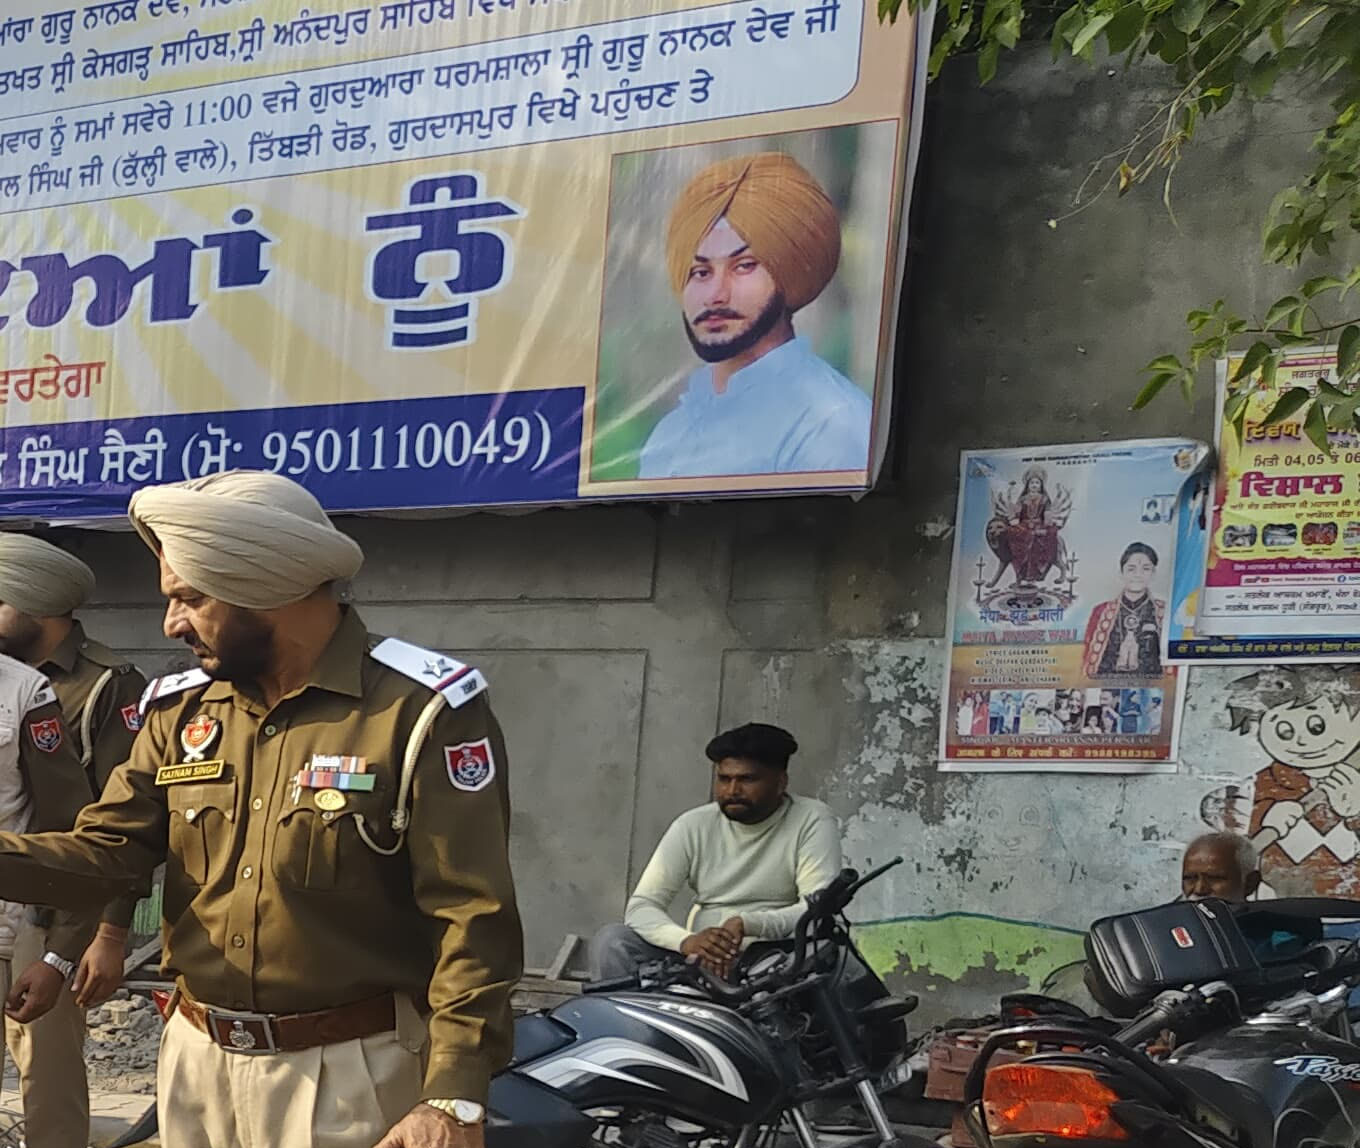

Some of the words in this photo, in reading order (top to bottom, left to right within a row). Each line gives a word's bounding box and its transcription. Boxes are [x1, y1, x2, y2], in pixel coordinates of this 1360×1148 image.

[41, 10, 76, 44] ਗੁਰੂ
[83, 0, 139, 29] ਨਾਨਕ
[273, 9, 370, 45] ਅਨੰਦਪੁਰ
[50, 115, 67, 156] ਨੂੰ
[74, 111, 115, 143] ਸਮਾਂ
[122, 101, 174, 136] ਸਵੇਰੇ
[183, 93, 253, 128] 11:00
[262, 80, 301, 114] ਵਜੇ
[309, 69, 425, 114] ਗੁਰਦੁਆਰਾ
[602, 34, 648, 72] ਗੁਰੂ
[659, 20, 736, 56] ਨਾਨਕ
[745, 8, 795, 42] ਦੇਵ
[804, 0, 842, 35] ਜੀ
[29, 162, 72, 194] ਸਿੰਘ
[80, 155, 104, 187] ਜੀ
[176, 139, 237, 174] ਵਾਲੇ),
[248, 123, 322, 165] ਤਿੱਬੜੀ
[332, 119, 378, 153] ਰੋਡ,
[388, 104, 517, 151] ਗੁਰਦਾਸਪੁਰ
[526, 88, 581, 127] ਵਿਖੇ
[591, 79, 680, 120] ਪਹੁੰਚਣ
[689, 69, 715, 103] ਤੇ
[365, 174, 523, 349] ਨੂੰ
[19, 434, 89, 489] ਸਿੰਘ
[98, 428, 168, 483] ਸੈਣੀ
[262, 410, 552, 474] 9501110049)
[1284, 453, 1325, 467] 04,05
[161, 767, 192, 780] SATNAM
